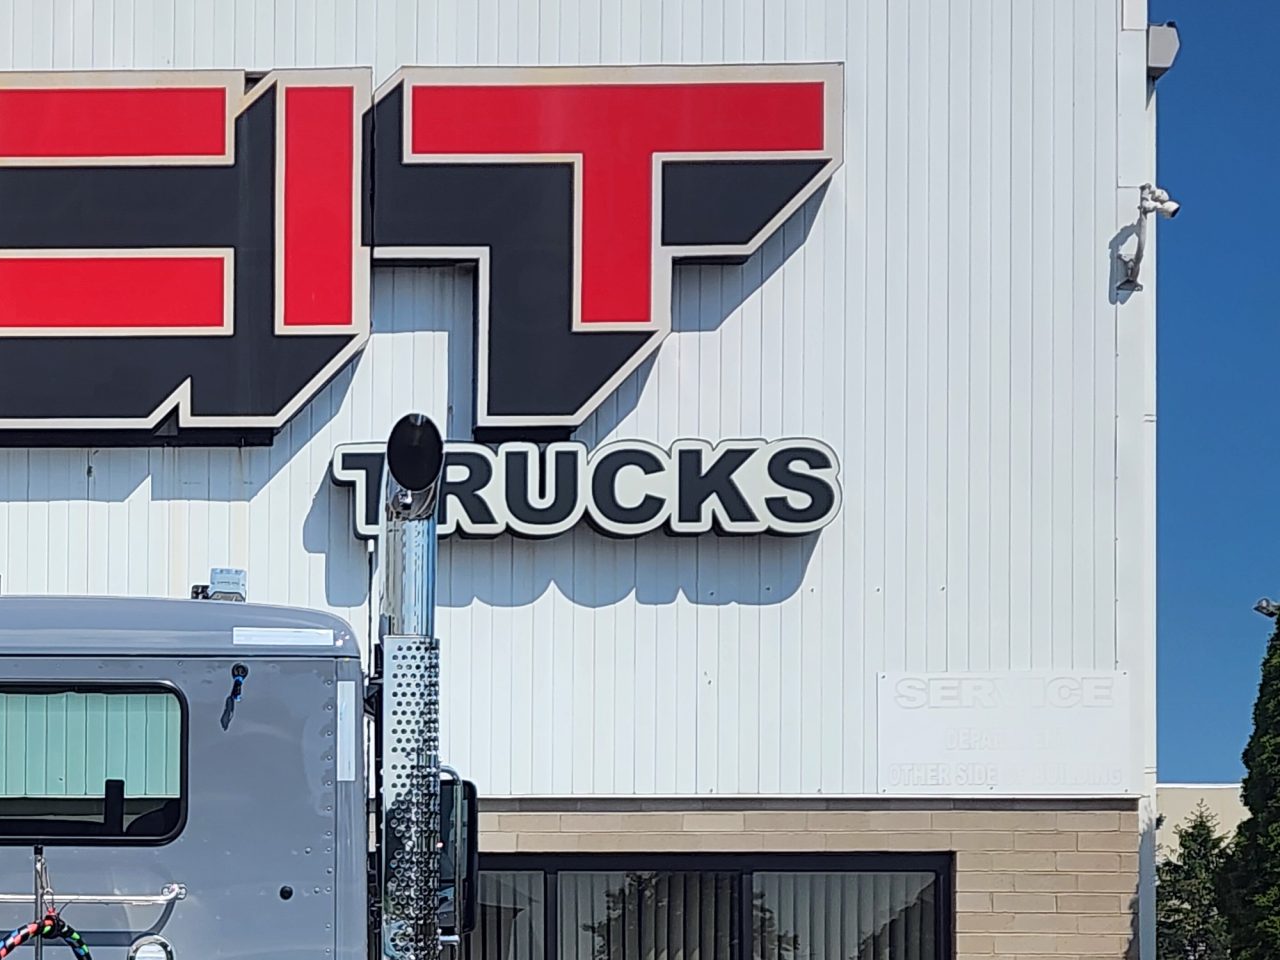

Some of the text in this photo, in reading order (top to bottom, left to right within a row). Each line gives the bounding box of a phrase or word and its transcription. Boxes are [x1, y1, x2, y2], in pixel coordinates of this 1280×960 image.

[340, 448, 834, 525] TRUCKS
[888, 763, 951, 786] OTHER
[955, 763, 999, 786] SIDE
